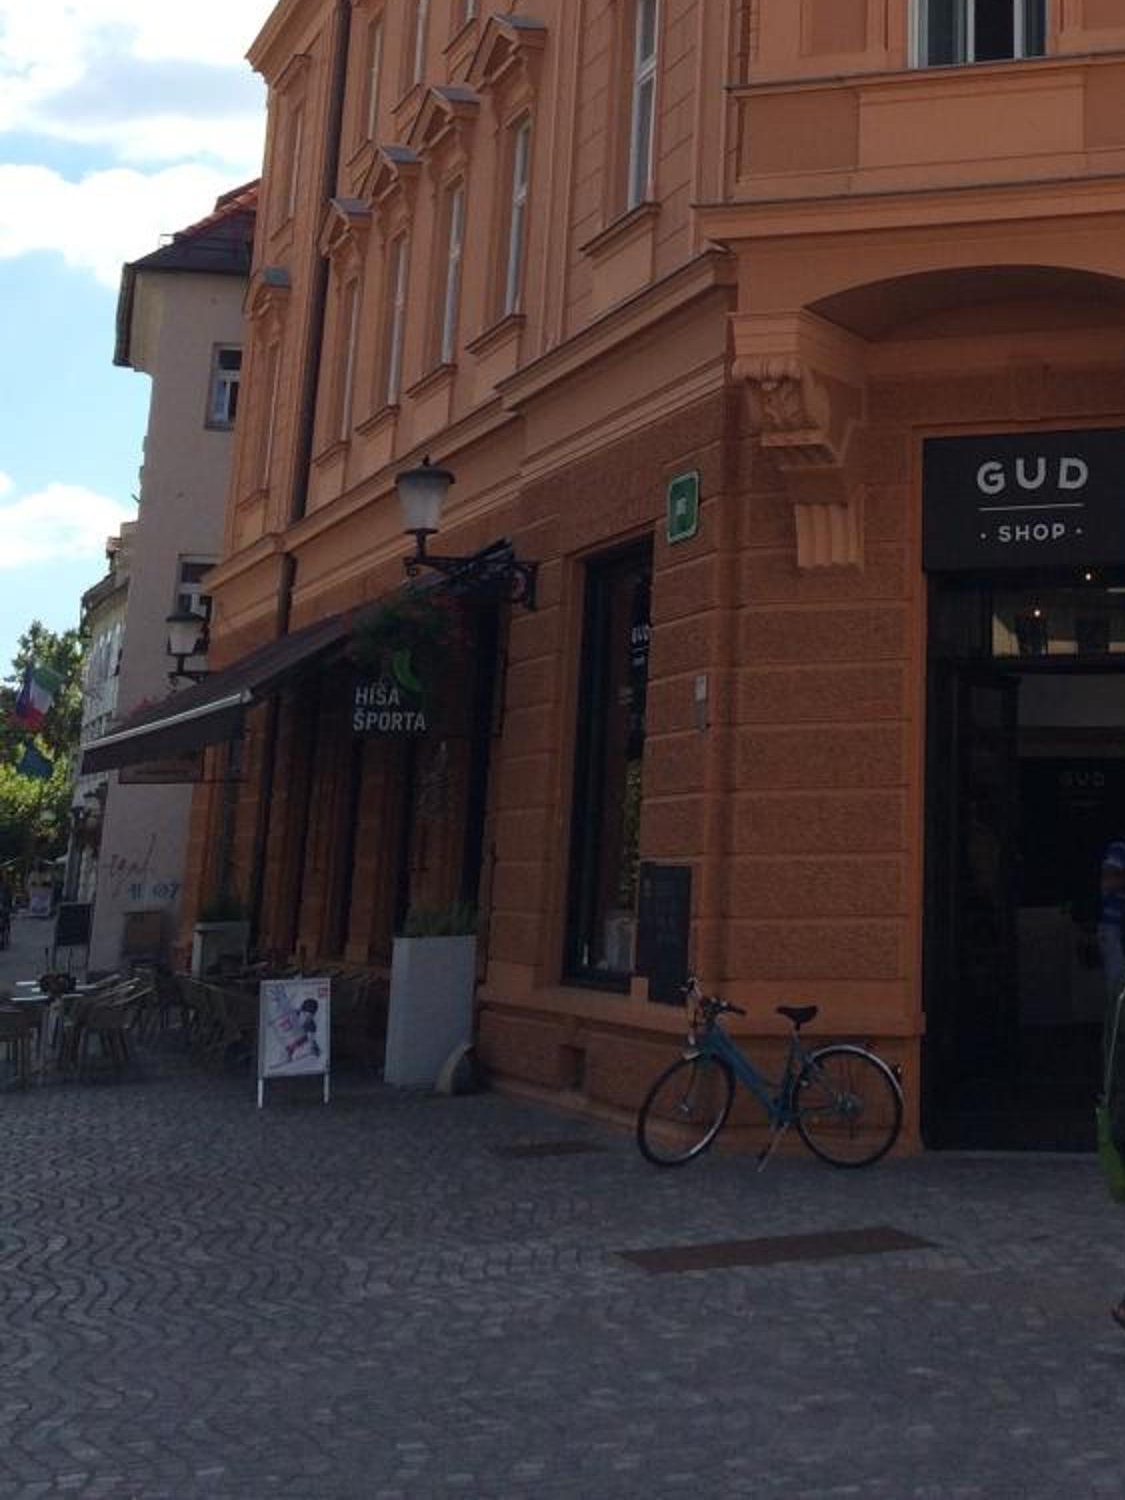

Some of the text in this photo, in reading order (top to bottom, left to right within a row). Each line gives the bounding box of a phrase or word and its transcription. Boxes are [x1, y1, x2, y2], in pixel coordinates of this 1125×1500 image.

[977, 457, 1089, 495] GUD
[997, 522, 1066, 543] SHOP
[353, 708, 426, 731] ŠPORTA
